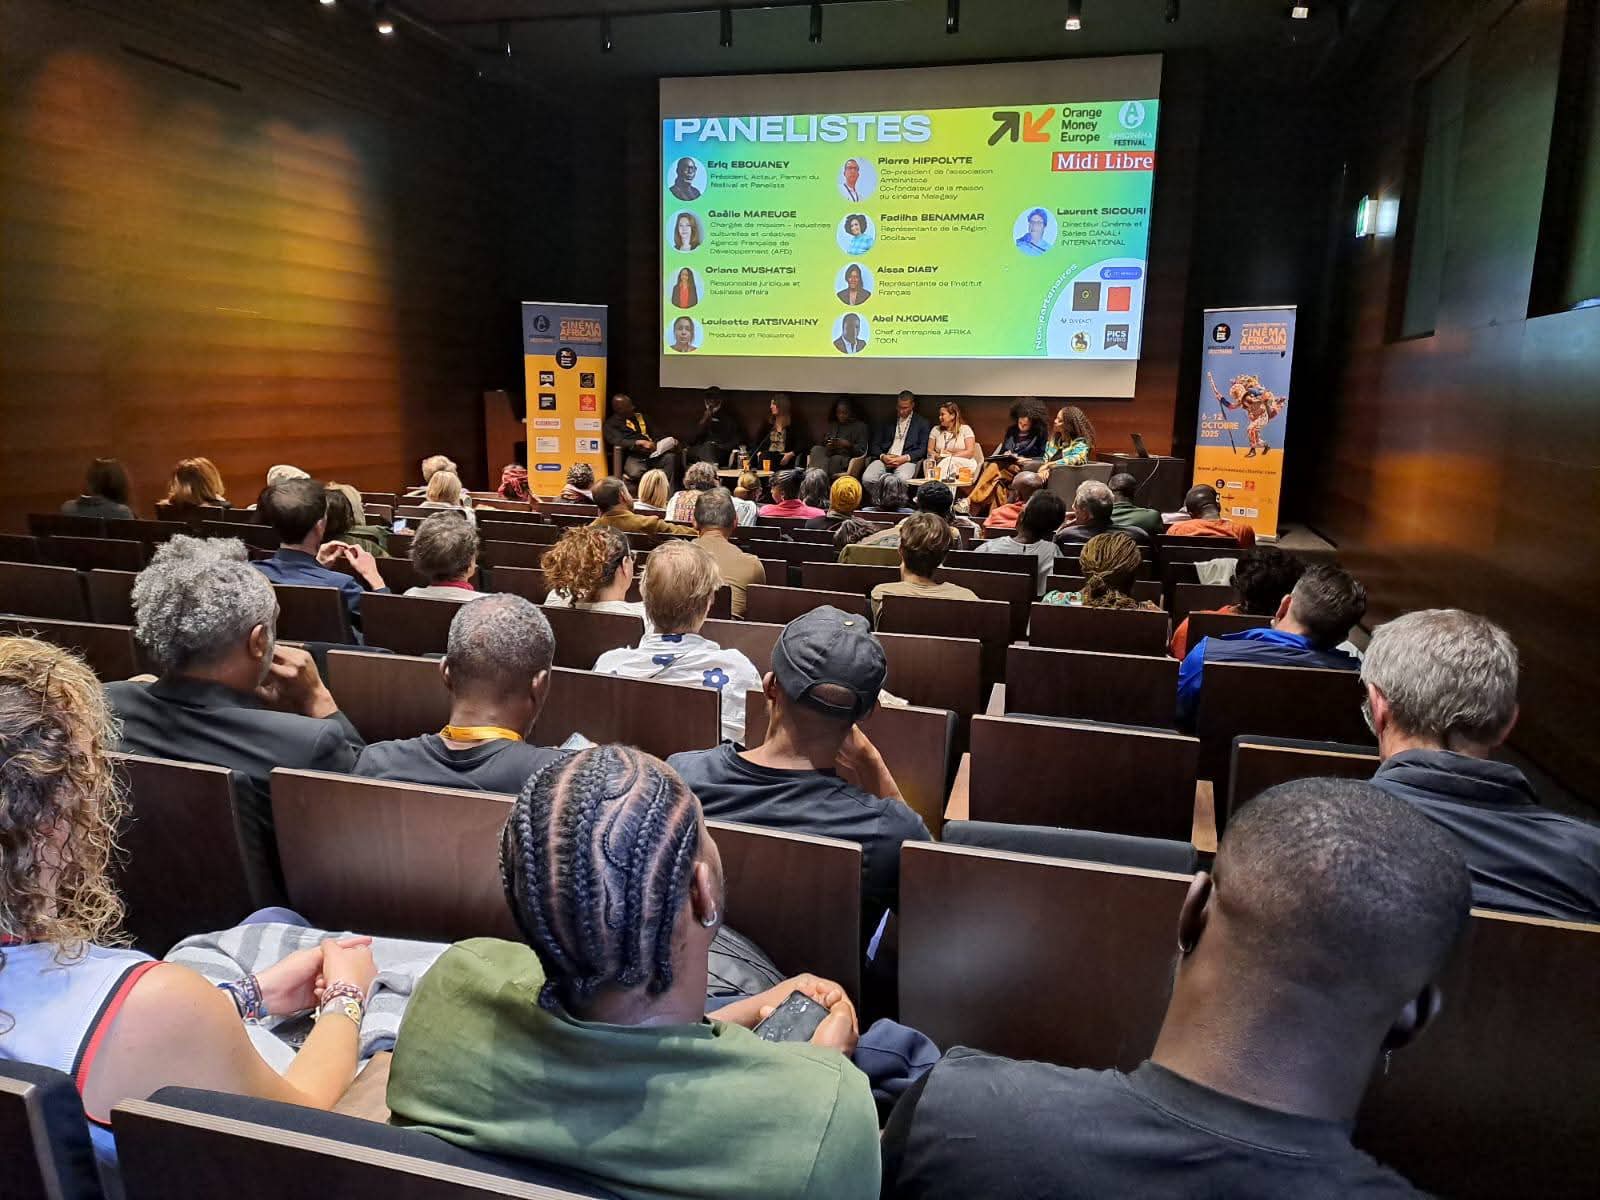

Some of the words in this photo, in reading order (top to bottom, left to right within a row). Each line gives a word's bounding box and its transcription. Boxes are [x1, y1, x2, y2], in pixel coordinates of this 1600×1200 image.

[1063, 108, 1102, 118] Orange
[674, 114, 932, 143] PANELISTES
[1061, 120, 1097, 131] Money
[1061, 132, 1100, 144] Europe
[731, 160, 790, 168] EBOUANEY
[1057, 153, 1098, 169] Midi
[1104, 153, 1153, 169] Libre
[921, 213, 985, 221] BENAMMAR
[1107, 330, 1127, 338] PICS
[1241, 335, 1287, 344] AFRICAIN
